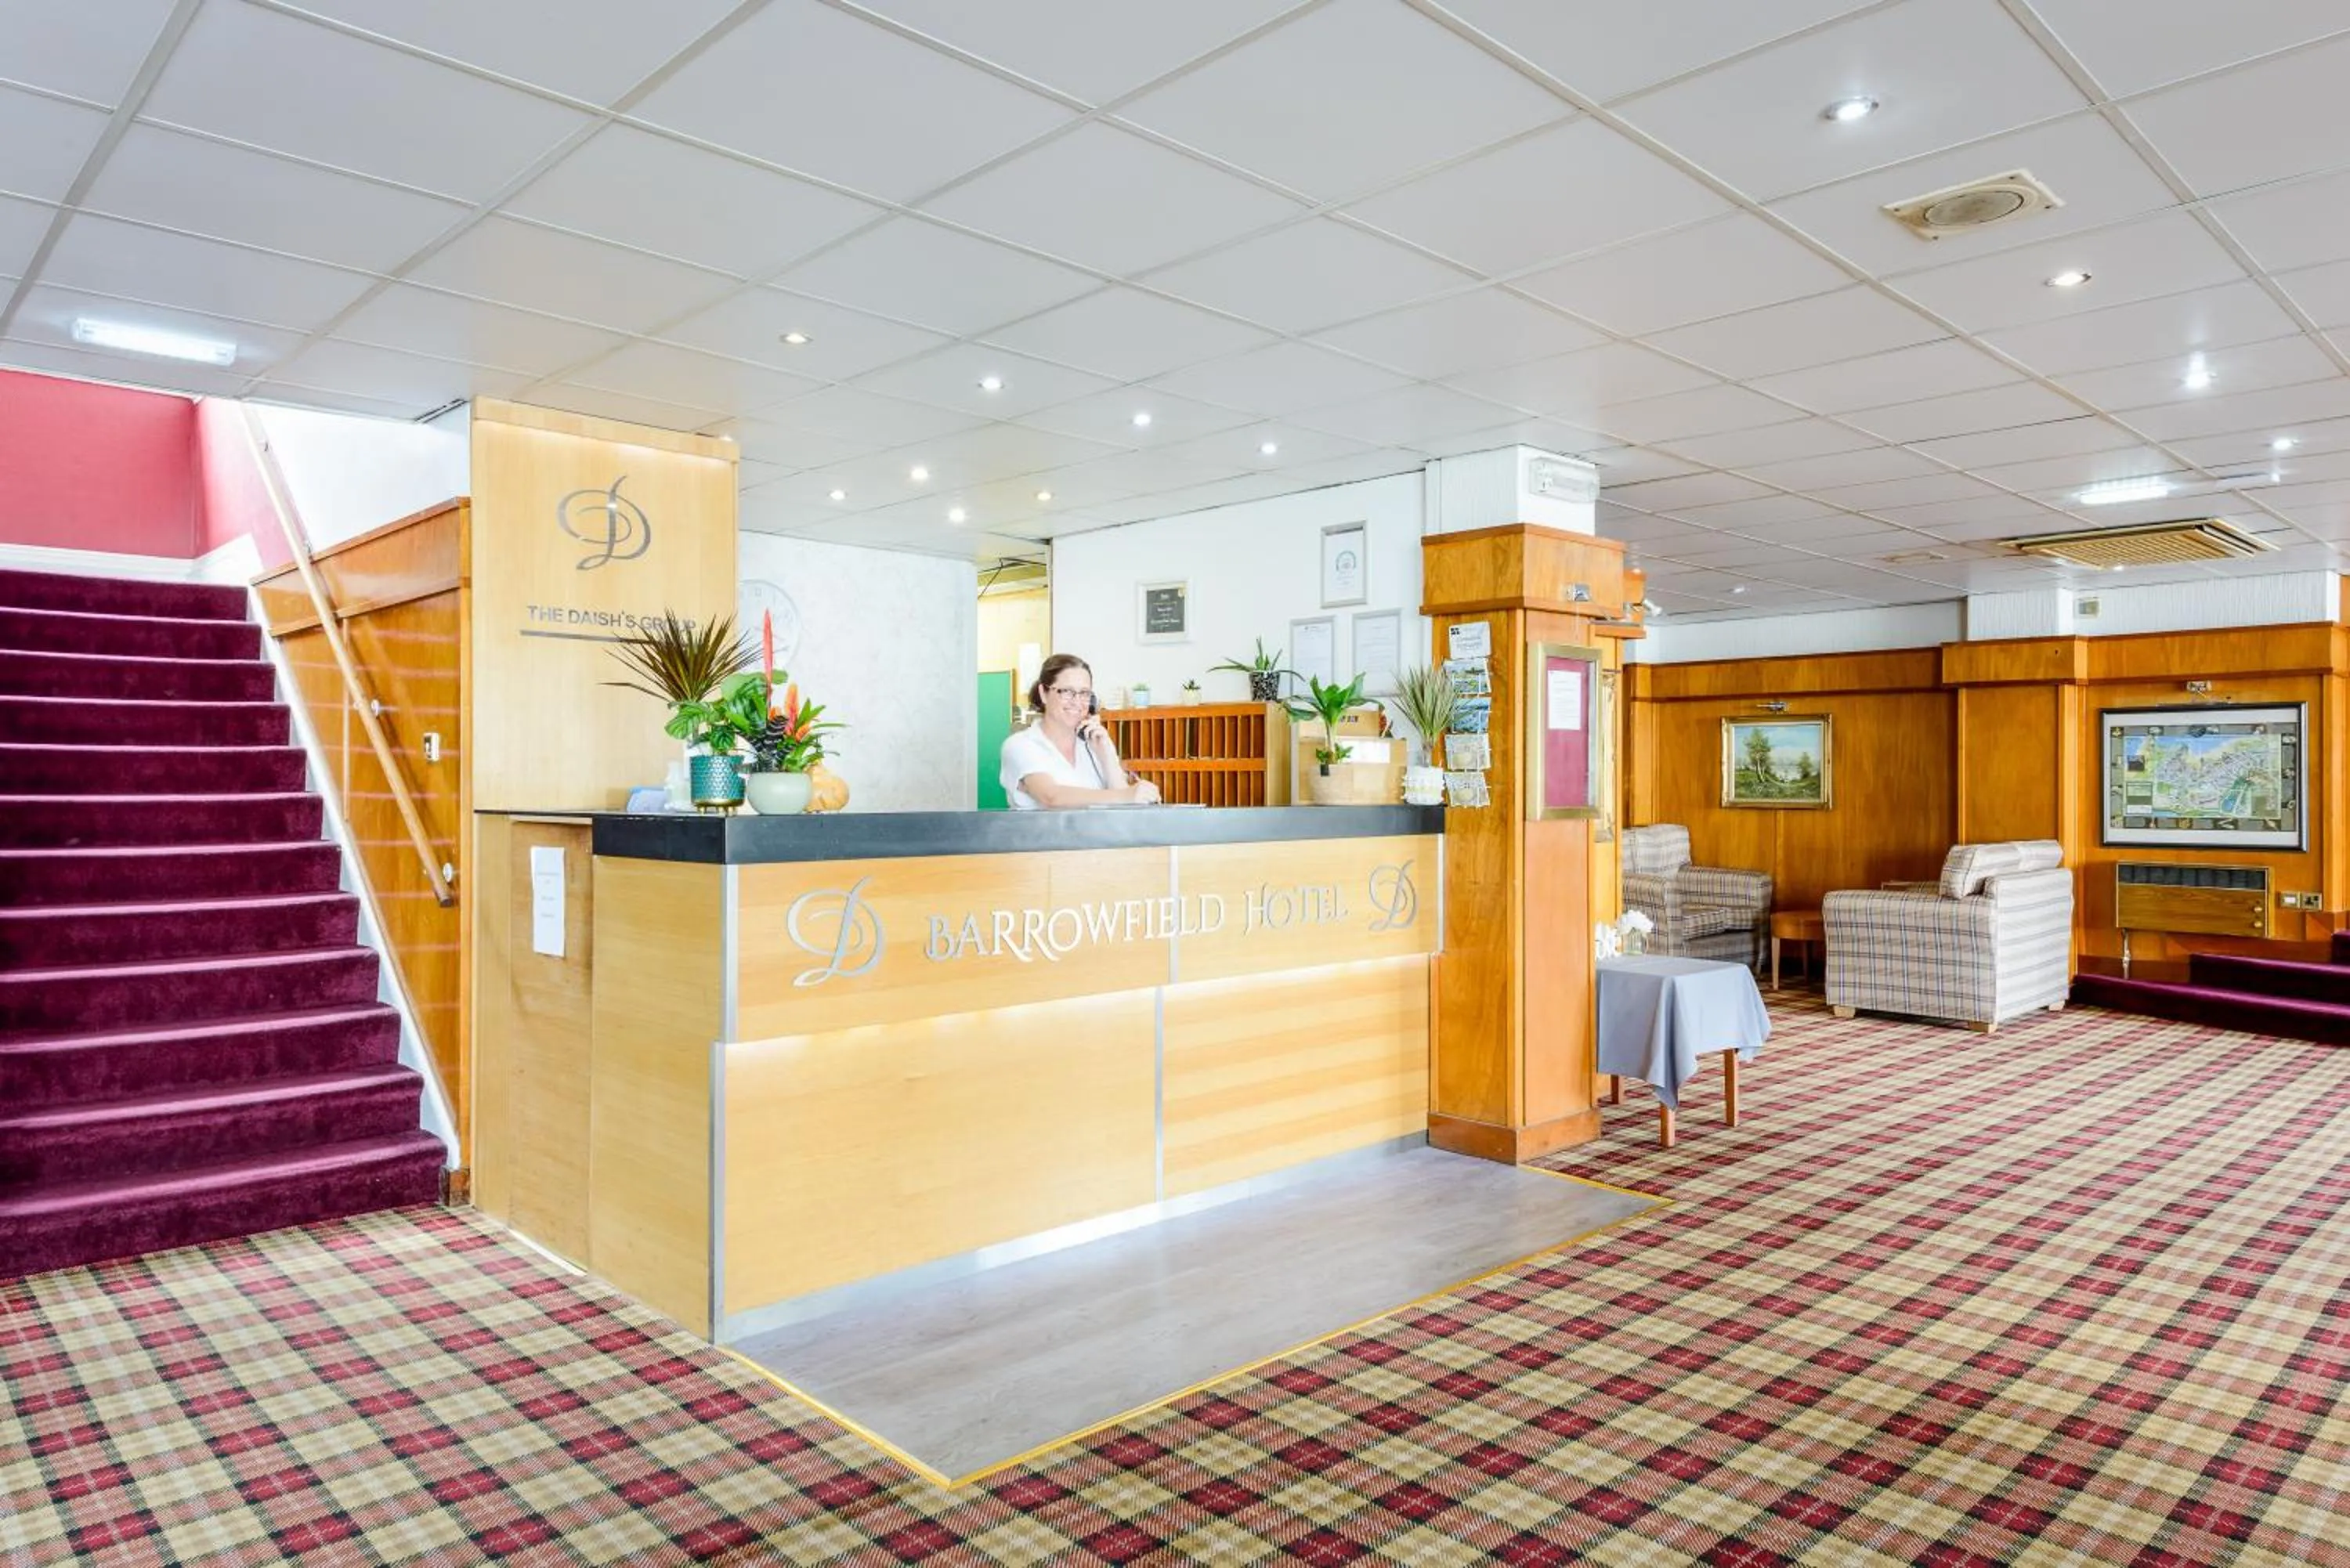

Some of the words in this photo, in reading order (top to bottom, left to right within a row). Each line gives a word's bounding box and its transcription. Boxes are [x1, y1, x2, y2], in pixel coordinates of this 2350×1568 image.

[526, 605, 564, 624] THE
[567, 609, 635, 629] DAISH'S
[924, 894, 1226, 963] BARROWFIELD
[1242, 882, 1349, 938] HOTEL
